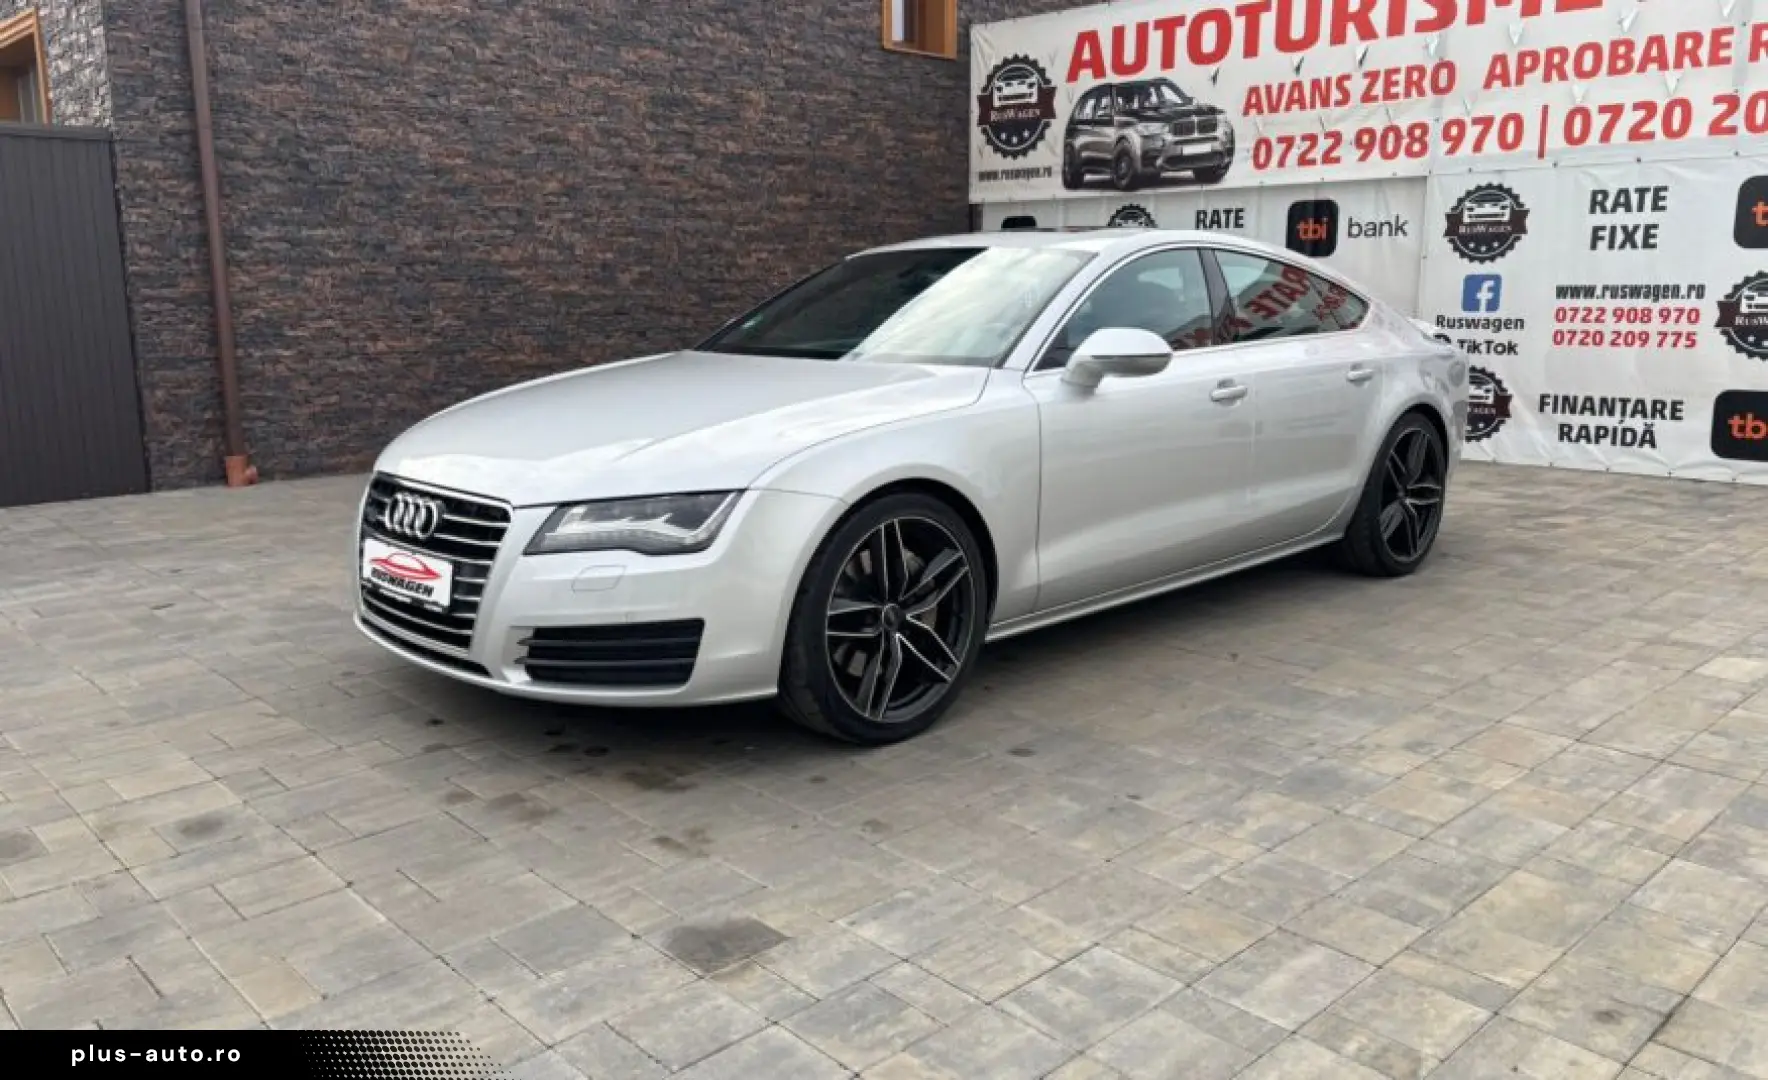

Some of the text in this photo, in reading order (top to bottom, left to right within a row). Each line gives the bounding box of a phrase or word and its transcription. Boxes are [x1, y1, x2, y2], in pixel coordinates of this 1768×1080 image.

[1243, 73, 1352, 117] AVANS
[1360, 61, 1457, 103] ZERO
[1483, 26, 1735, 90] APROBARE
[1253, 130, 1343, 170] 0722
[1355, 122, 1430, 162] 908
[1443, 112, 1524, 155] 970
[1563, 97, 1693, 146] 0720
[1708, 90, 1768, 136] 20
[1589, 185, 1669, 214] RATE
[1195, 207, 1245, 229] RATE
[1296, 214, 1408, 240] tbi bank
[1590, 223, 1660, 250] FIXE
[1555, 284, 1706, 303] www.ruswagen.ro
[1436, 315, 1525, 333] Ruswagen
[1555, 307, 1701, 325] 0722 908 970
[1457, 339, 1519, 356] TikTok
[1552, 330, 1698, 348] 0720 209 775
[1538, 393, 1685, 424] FINANȚARE
[1558, 422, 1657, 449] RAPIDĂ
